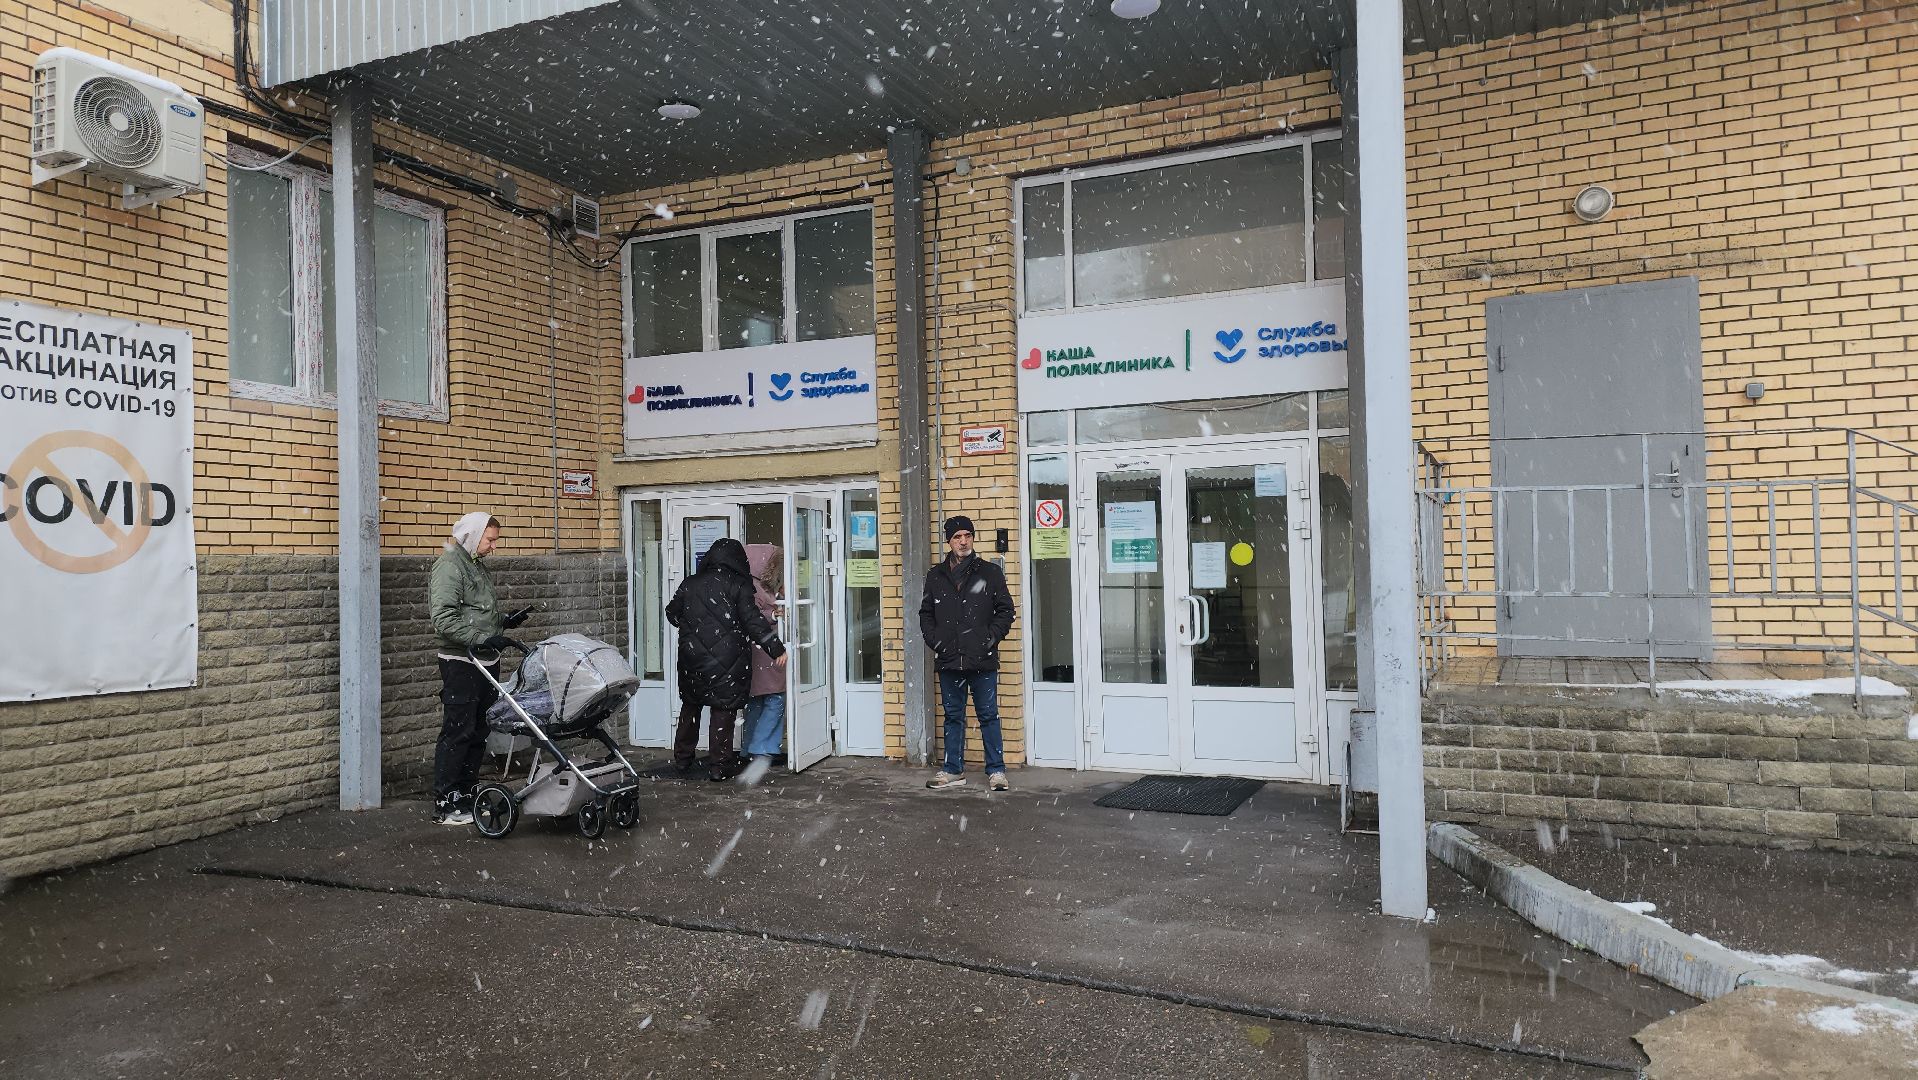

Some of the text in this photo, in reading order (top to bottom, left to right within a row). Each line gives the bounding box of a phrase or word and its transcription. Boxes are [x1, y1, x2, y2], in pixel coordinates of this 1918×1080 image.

[1258, 321, 1336, 342] Служба
[1047, 345, 1096, 362] НАША
[0, 347, 176, 391] АКЦИНАЦИЯ
[1047, 355, 1175, 378] ПОЛИКЛИНИКА
[801, 367, 857, 384] Служба
[647, 385, 684, 397] НАША
[801, 383, 870, 398] здоровья
[65, 388, 176, 418] COVID-19
[647, 395, 743, 411] ПОЛИКЛИНИКА
